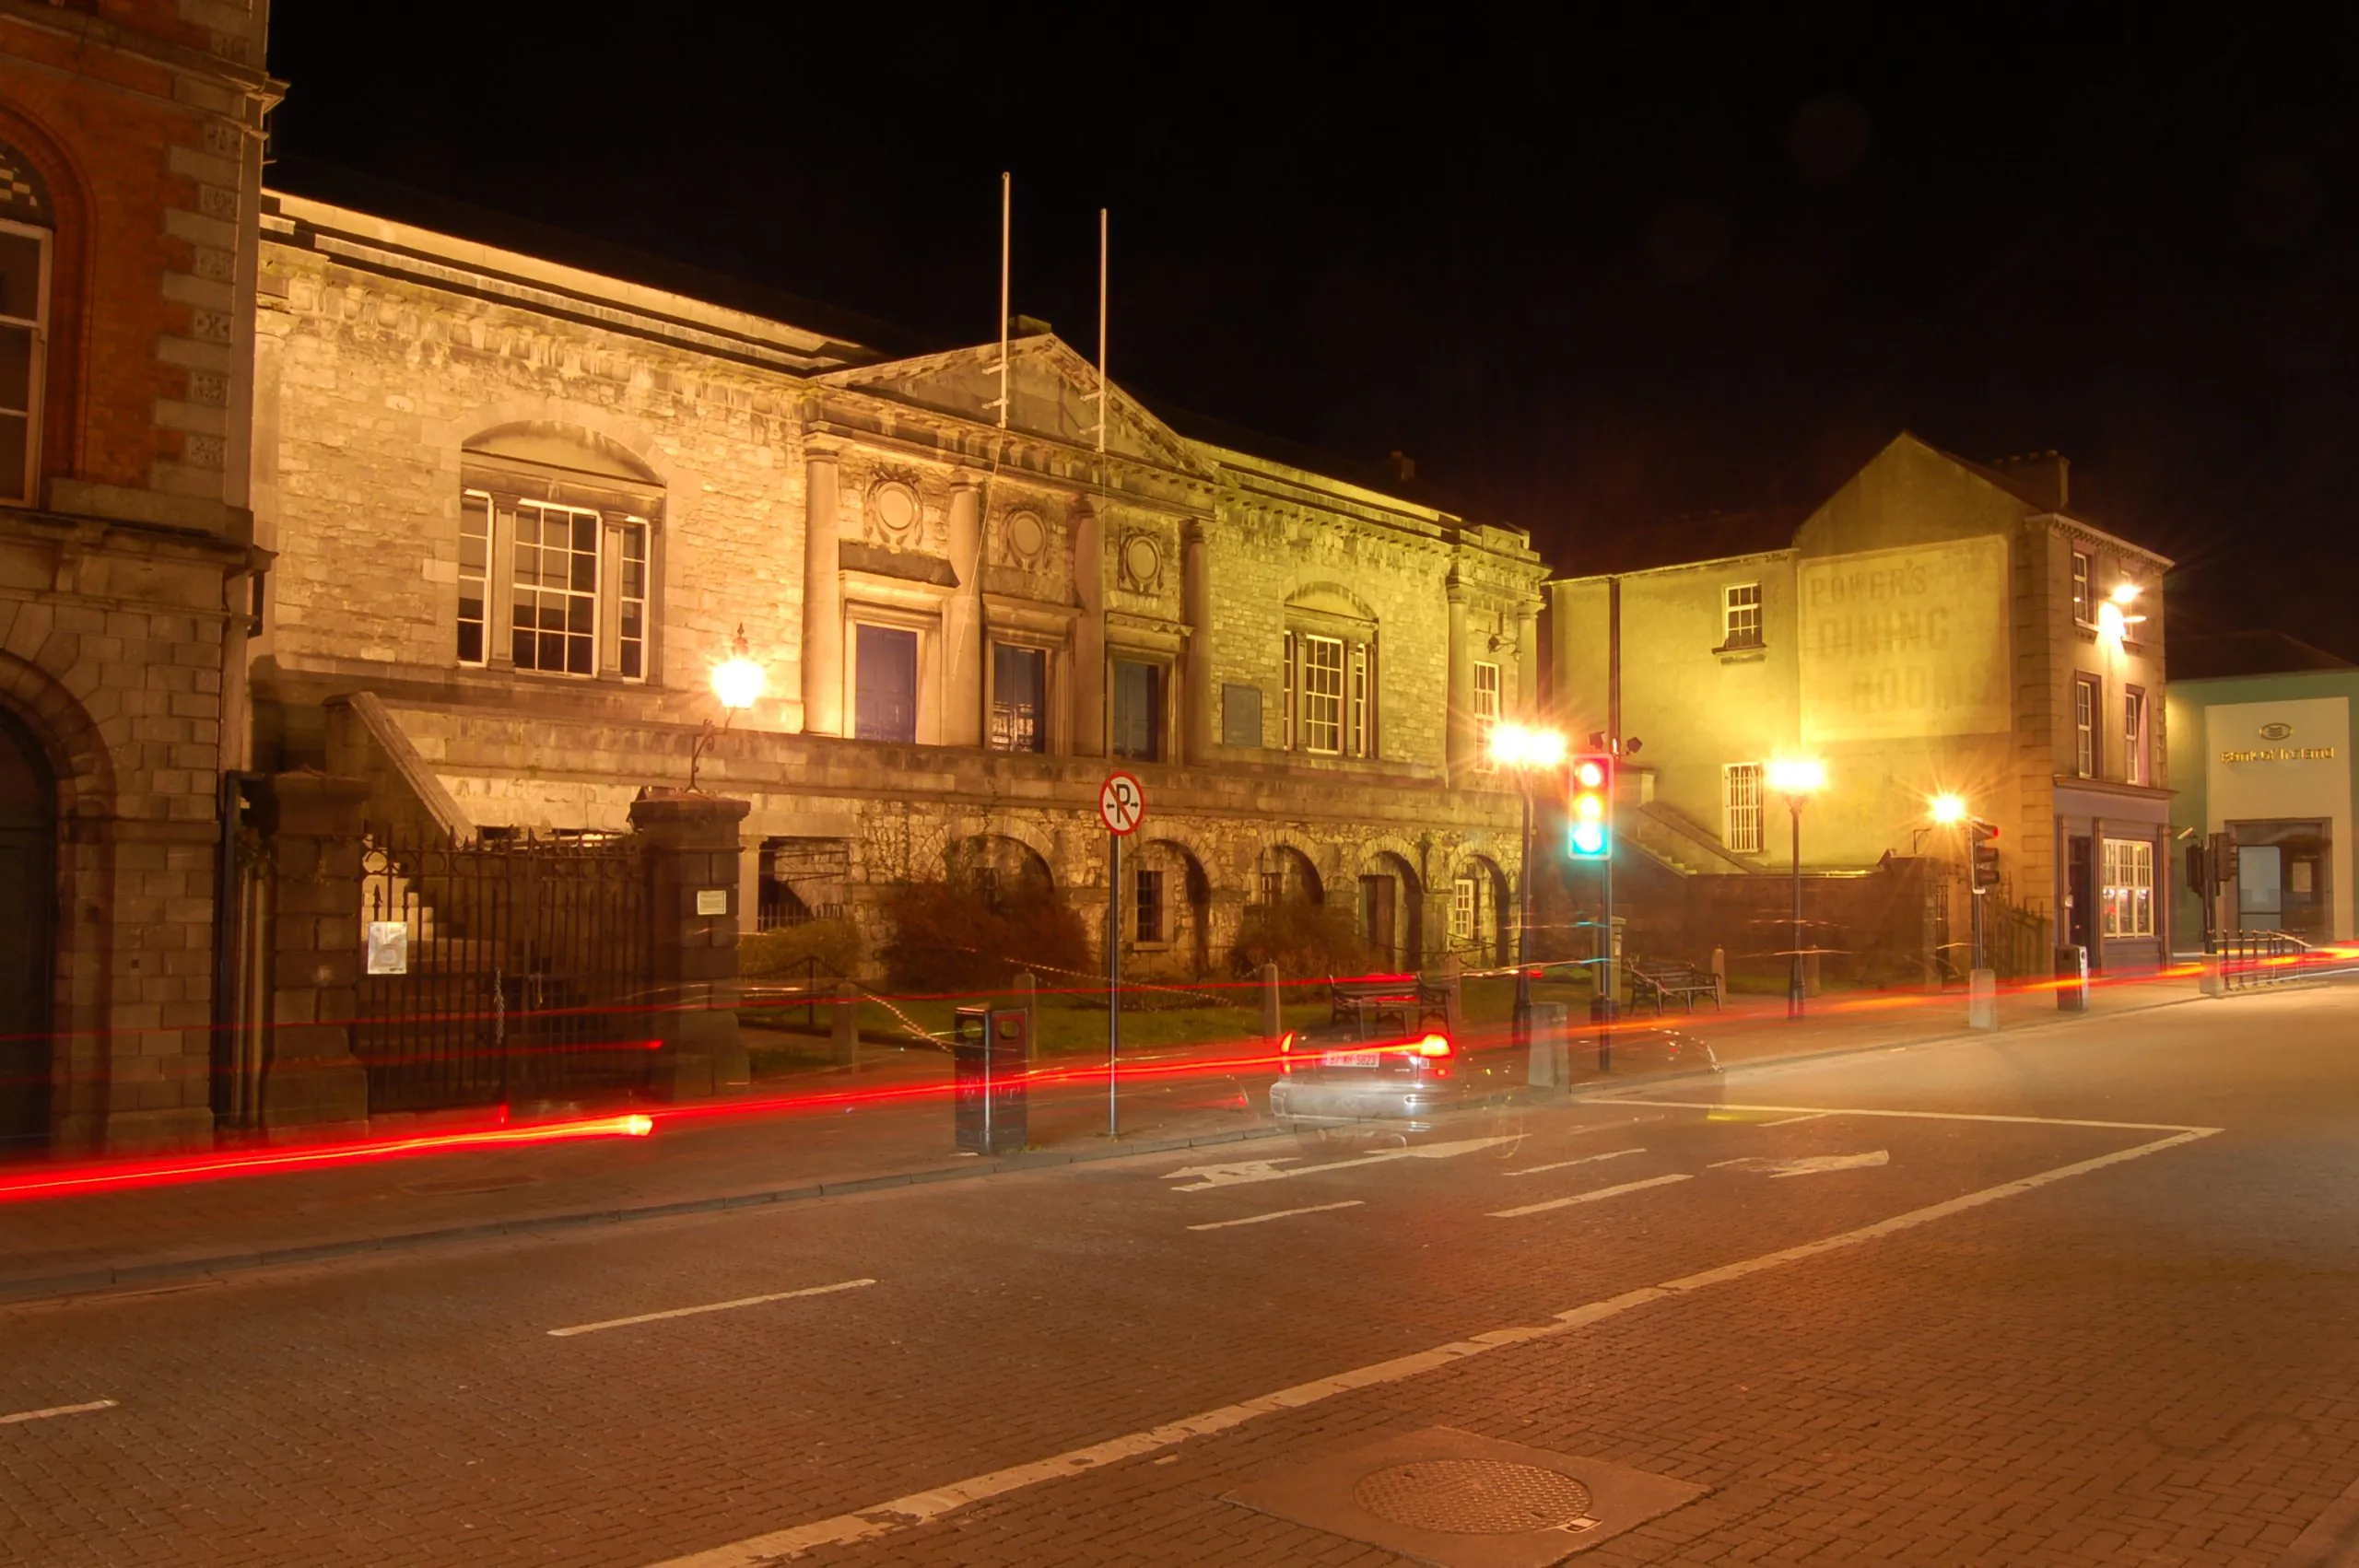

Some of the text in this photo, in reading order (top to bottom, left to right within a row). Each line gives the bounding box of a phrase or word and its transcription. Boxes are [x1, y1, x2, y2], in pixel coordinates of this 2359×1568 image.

[1811, 559, 1927, 608] POWER'S
[1818, 605, 1950, 659] DINING
[2222, 747, 2335, 764] Bank of Ireland
[1116, 783, 1132, 825] P
